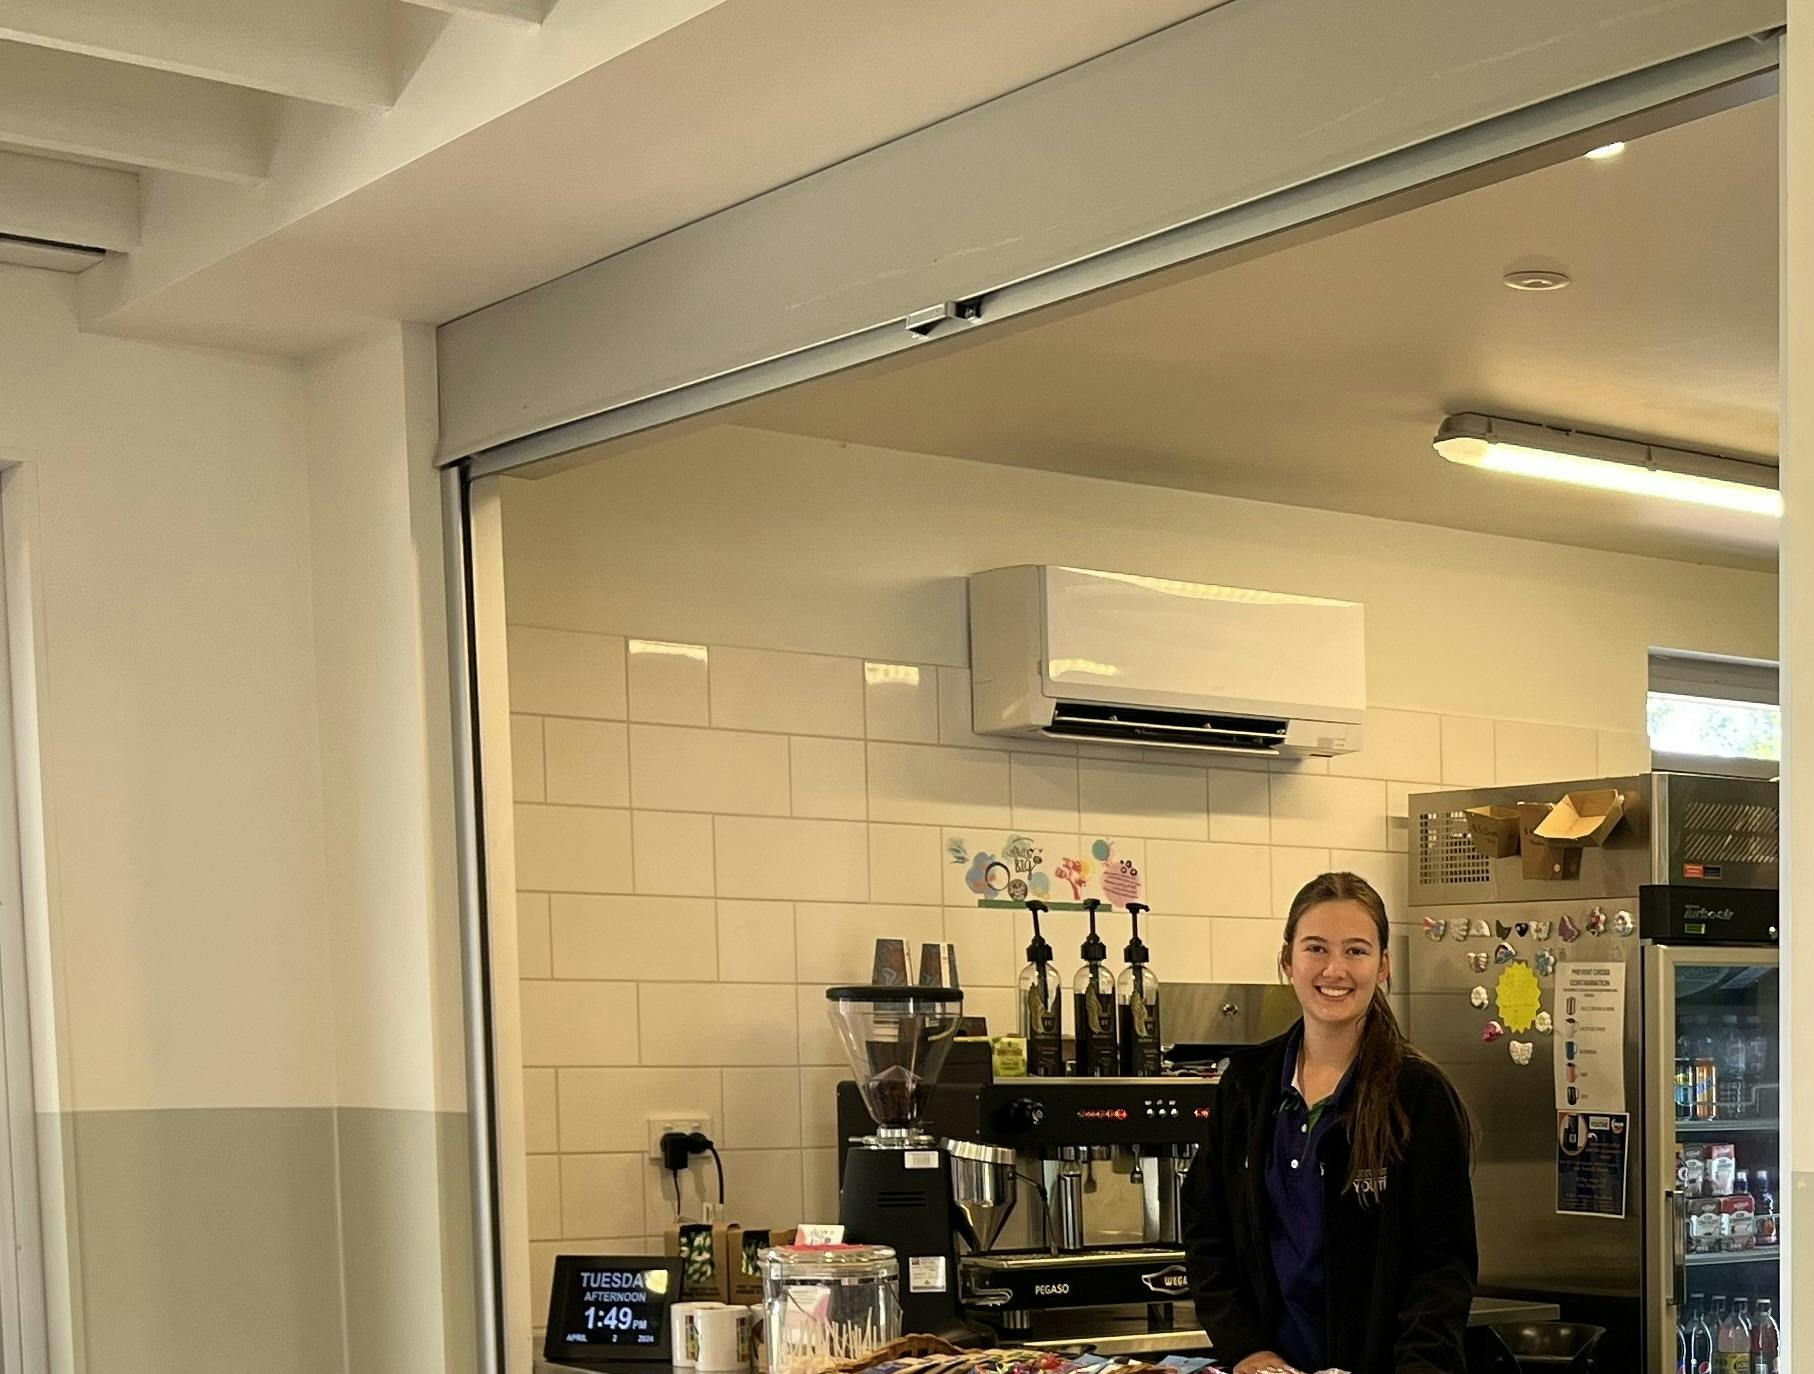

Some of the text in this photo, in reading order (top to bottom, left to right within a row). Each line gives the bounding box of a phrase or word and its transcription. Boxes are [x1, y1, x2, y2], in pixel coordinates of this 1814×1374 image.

[580, 1271, 645, 1288] TUESDA
[1035, 1283, 1070, 1295] PEGASO
[584, 1291, 646, 1302] AFTERNOON
[584, 1306, 647, 1330] 1:49 PM
[566, 1333, 588, 1342] APRIL
[612, 1334, 618, 1343] 2
